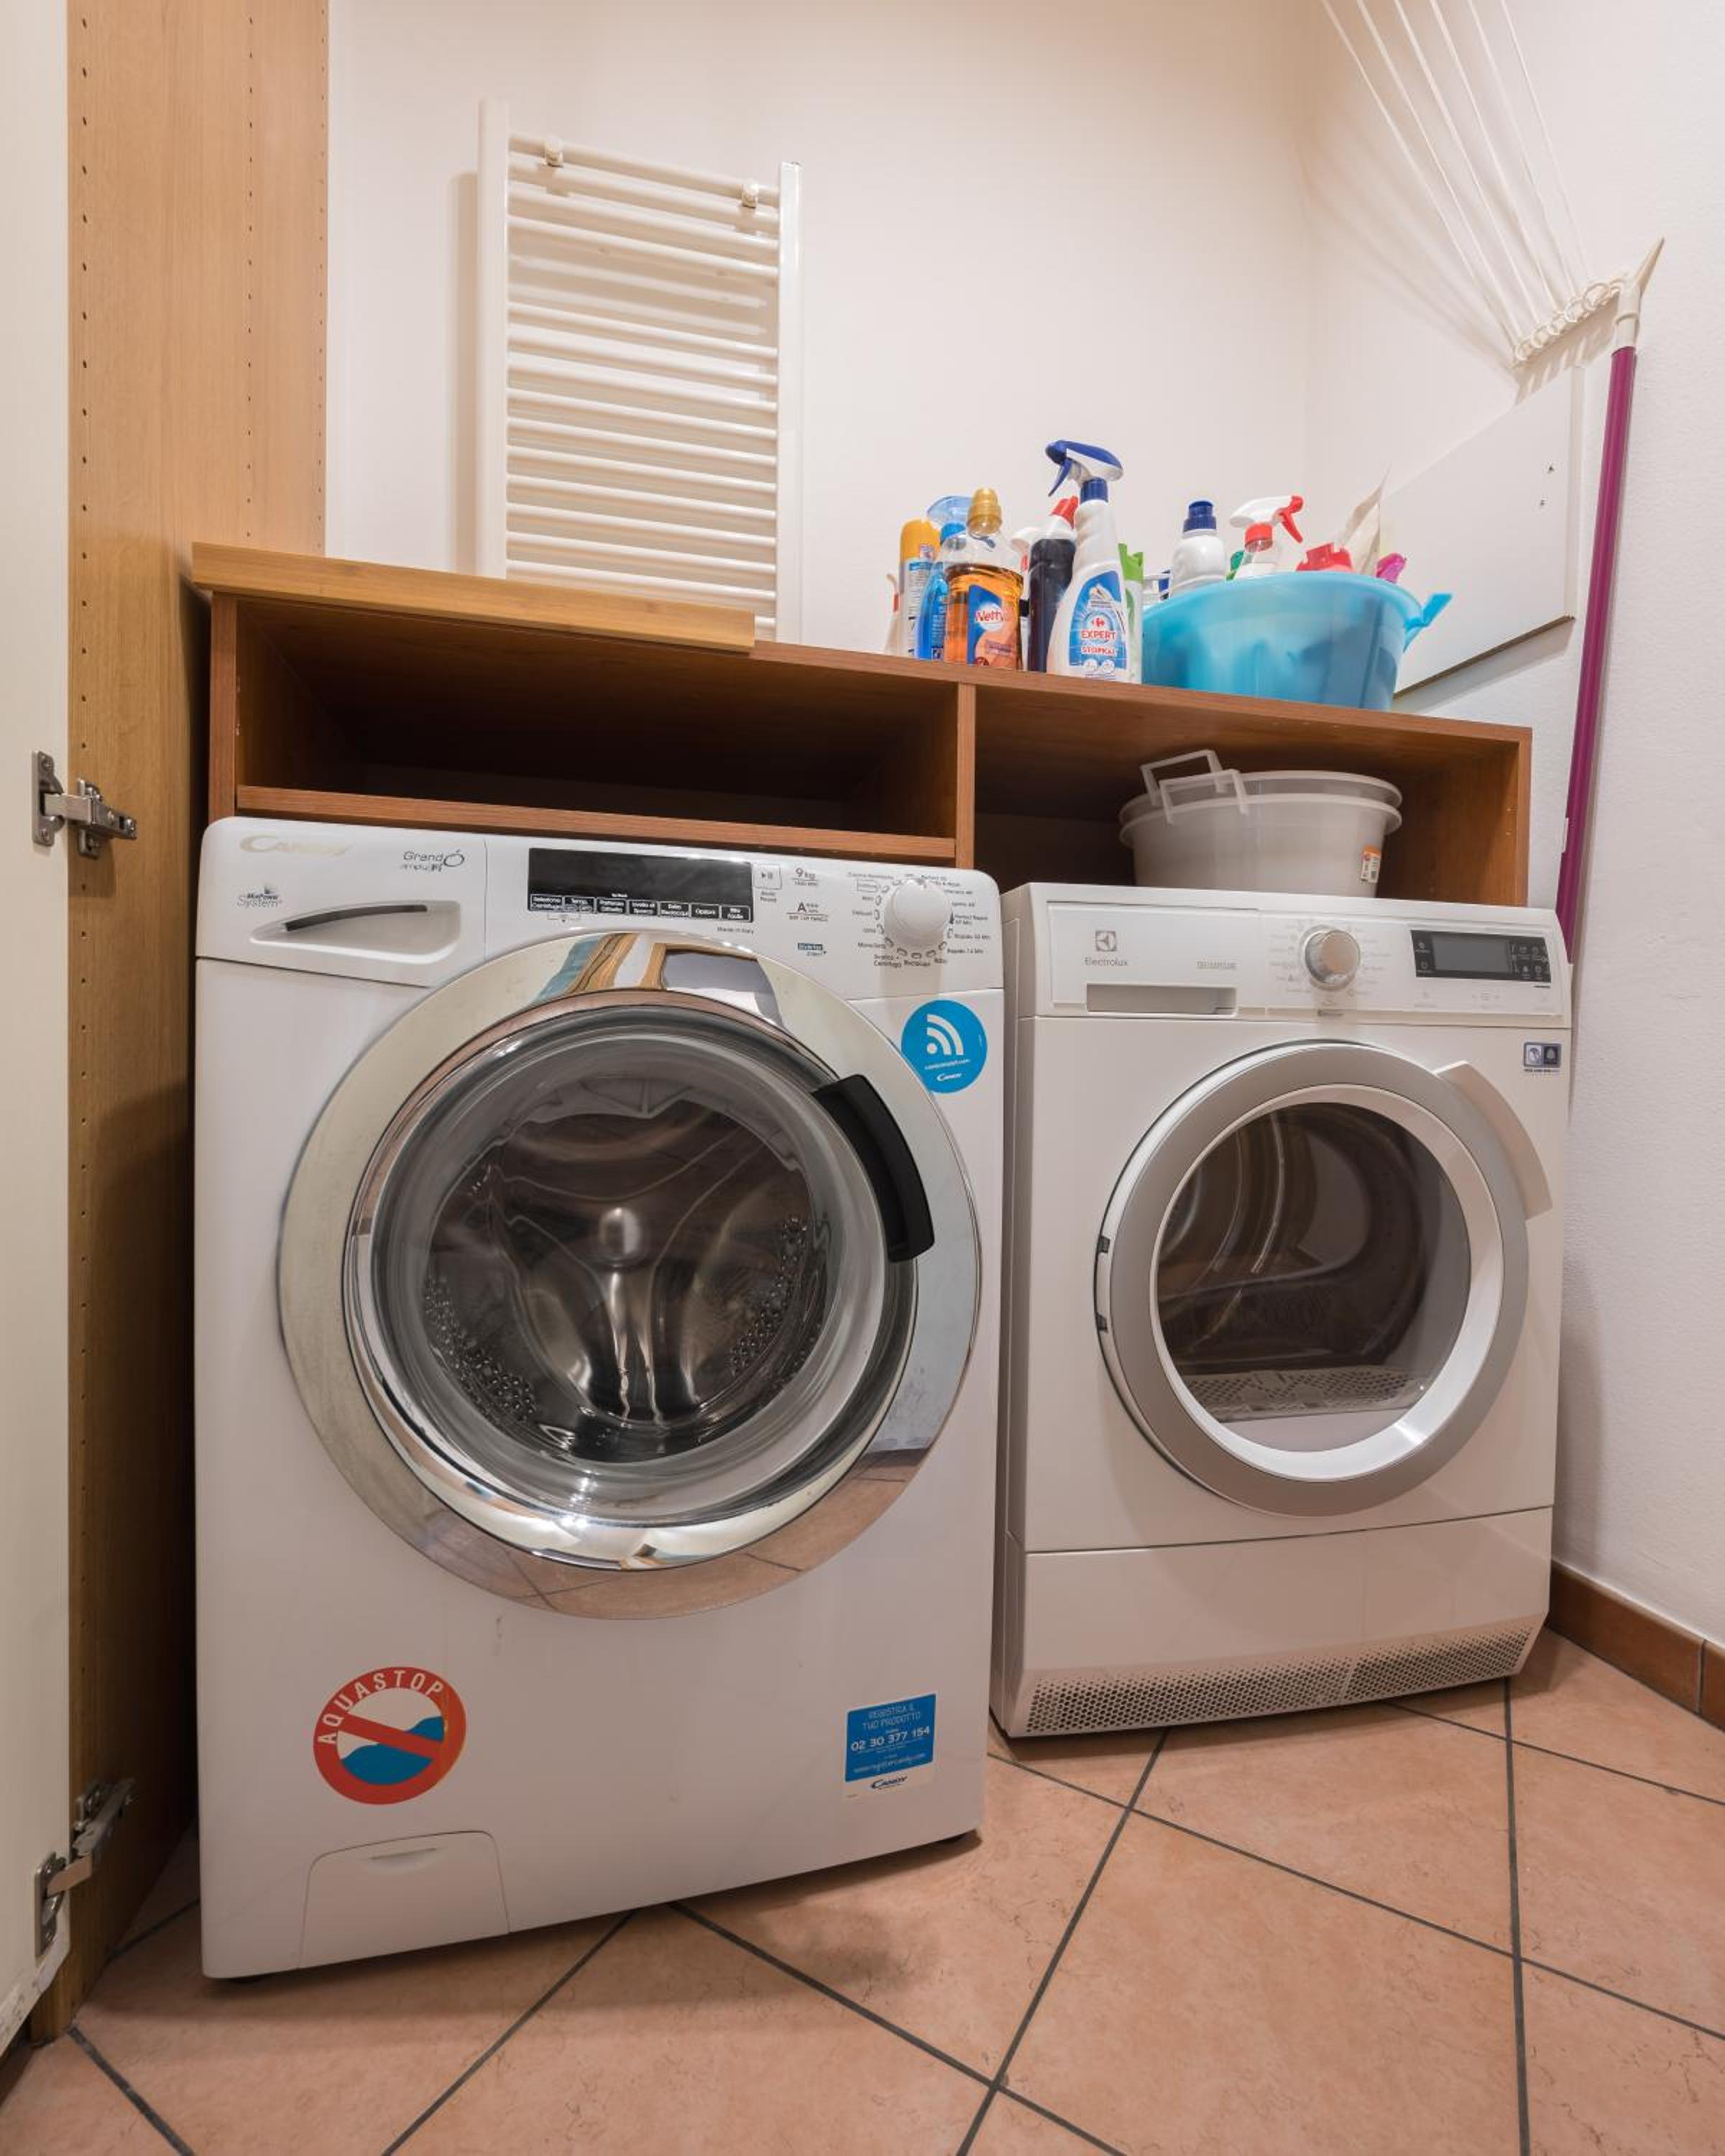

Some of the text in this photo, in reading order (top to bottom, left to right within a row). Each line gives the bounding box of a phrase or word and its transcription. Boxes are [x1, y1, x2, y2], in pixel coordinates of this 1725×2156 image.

[1081, 630, 1116, 640] EXPERT
[795, 867, 804, 877] 9
[1084, 957, 1128, 967] Electrolux
[317, 1670, 444, 1745] AQUASTOP
[850, 1739, 866, 1751] 02
[870, 1736, 885, 1747] 30
[888, 1731, 908, 1744] 377
[913, 1726, 929, 1738] 154
